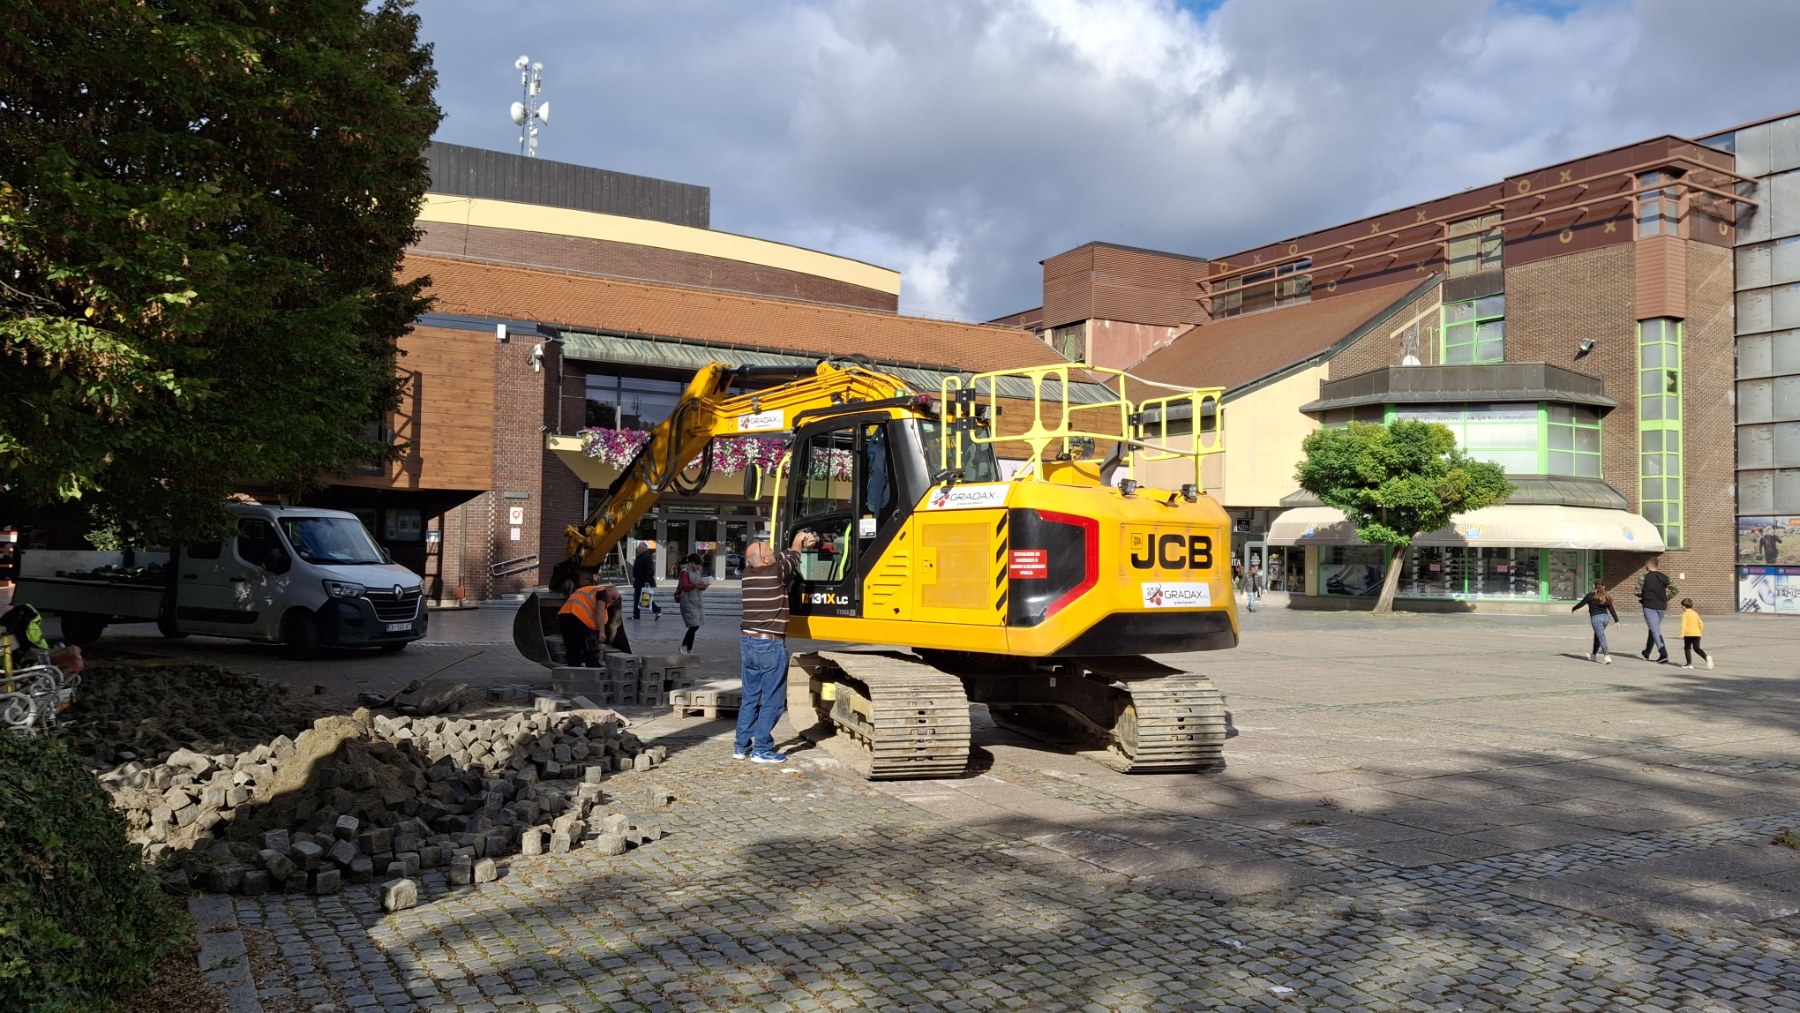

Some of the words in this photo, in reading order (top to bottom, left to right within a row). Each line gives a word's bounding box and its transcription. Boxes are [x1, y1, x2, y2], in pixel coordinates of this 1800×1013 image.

[751, 416, 777, 424] GRADAX
[950, 491, 997, 501] GRADAX
[1131, 534, 1213, 570] JCB
[1164, 590, 1203, 599] GRADAX
[836, 596, 849, 605] LC
